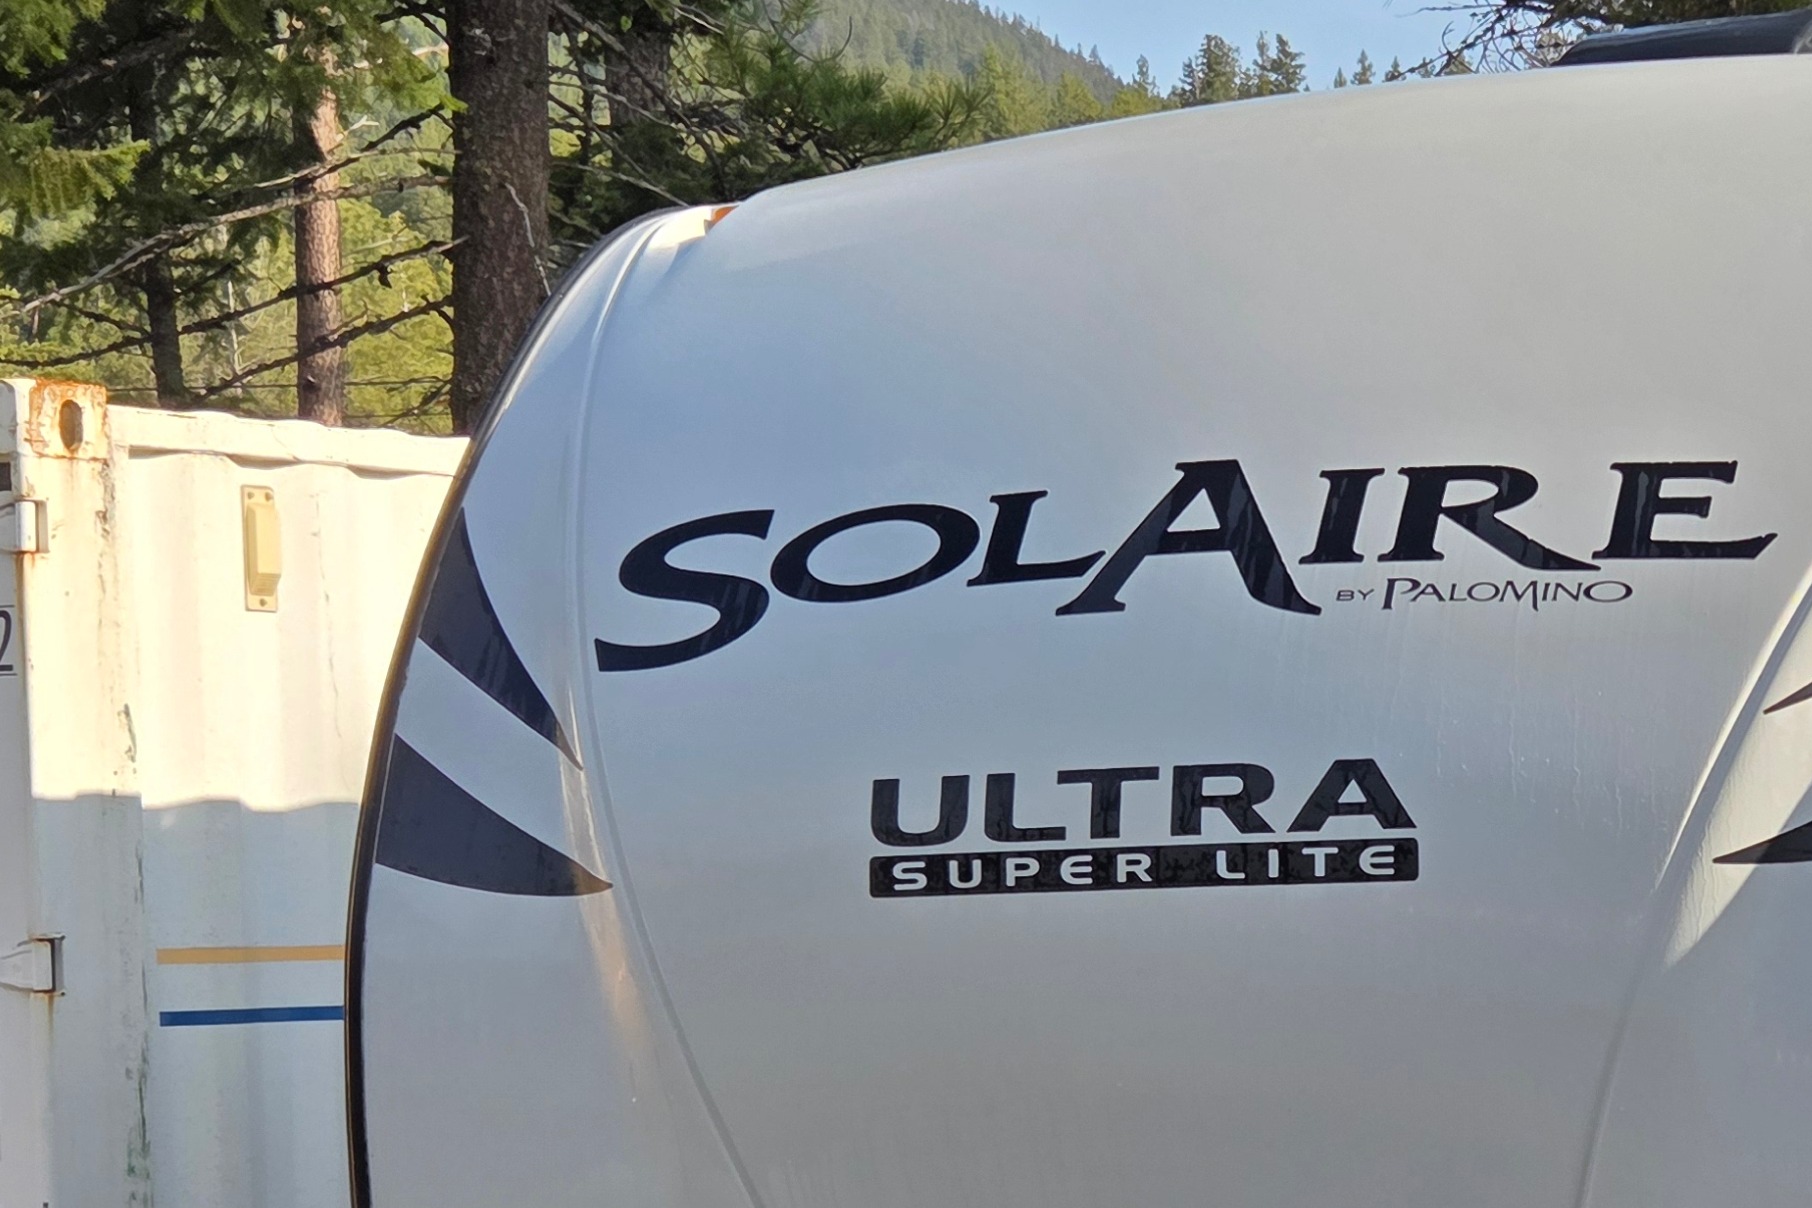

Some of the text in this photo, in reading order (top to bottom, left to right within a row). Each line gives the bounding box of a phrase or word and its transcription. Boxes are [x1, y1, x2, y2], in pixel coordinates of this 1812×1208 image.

[594, 459, 1778, 673] SOLAIRE
[1336, 577, 1634, 611] BY PALOMINO
[870, 758, 1417, 848] ULTRA
[893, 845, 1397, 891] SUPER LITE
